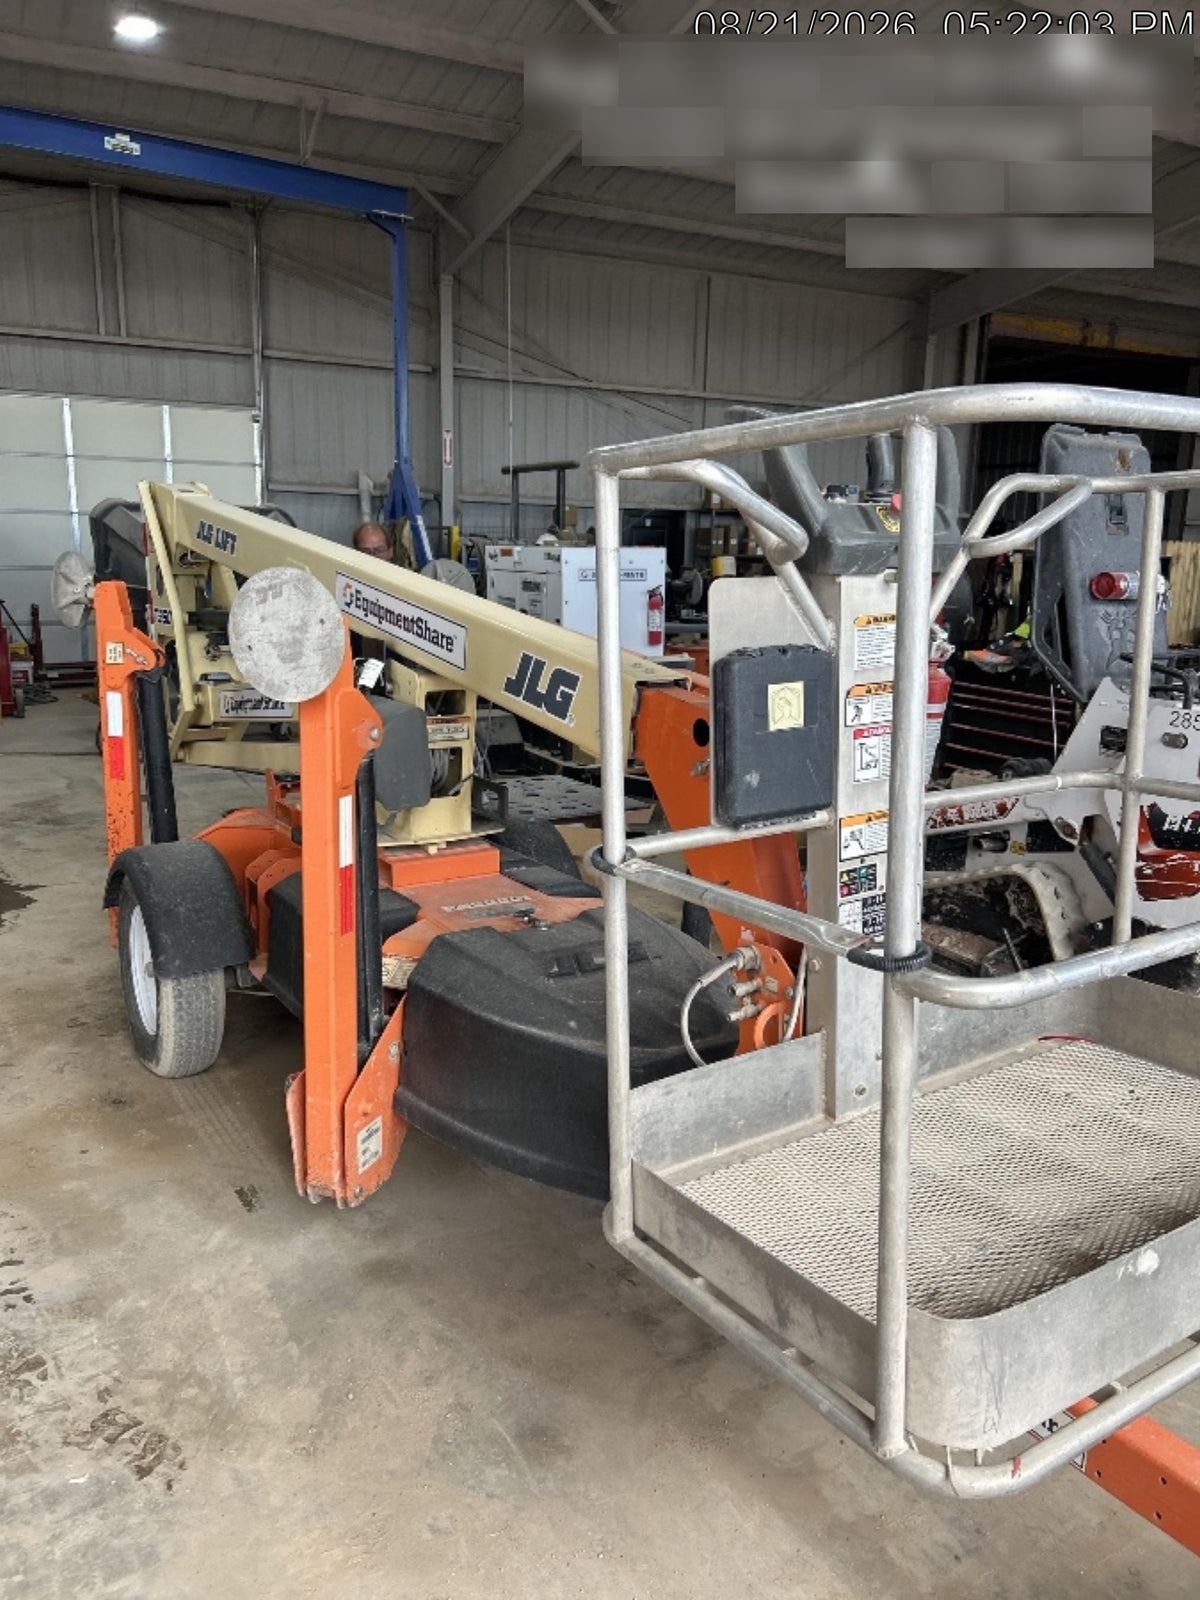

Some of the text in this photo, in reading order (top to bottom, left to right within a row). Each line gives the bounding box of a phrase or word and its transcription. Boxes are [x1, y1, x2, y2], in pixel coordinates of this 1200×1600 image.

[215, 527, 237, 556] LIFT
[354, 588, 454, 654] EquipmentShare
[503, 651, 582, 723] JLG
